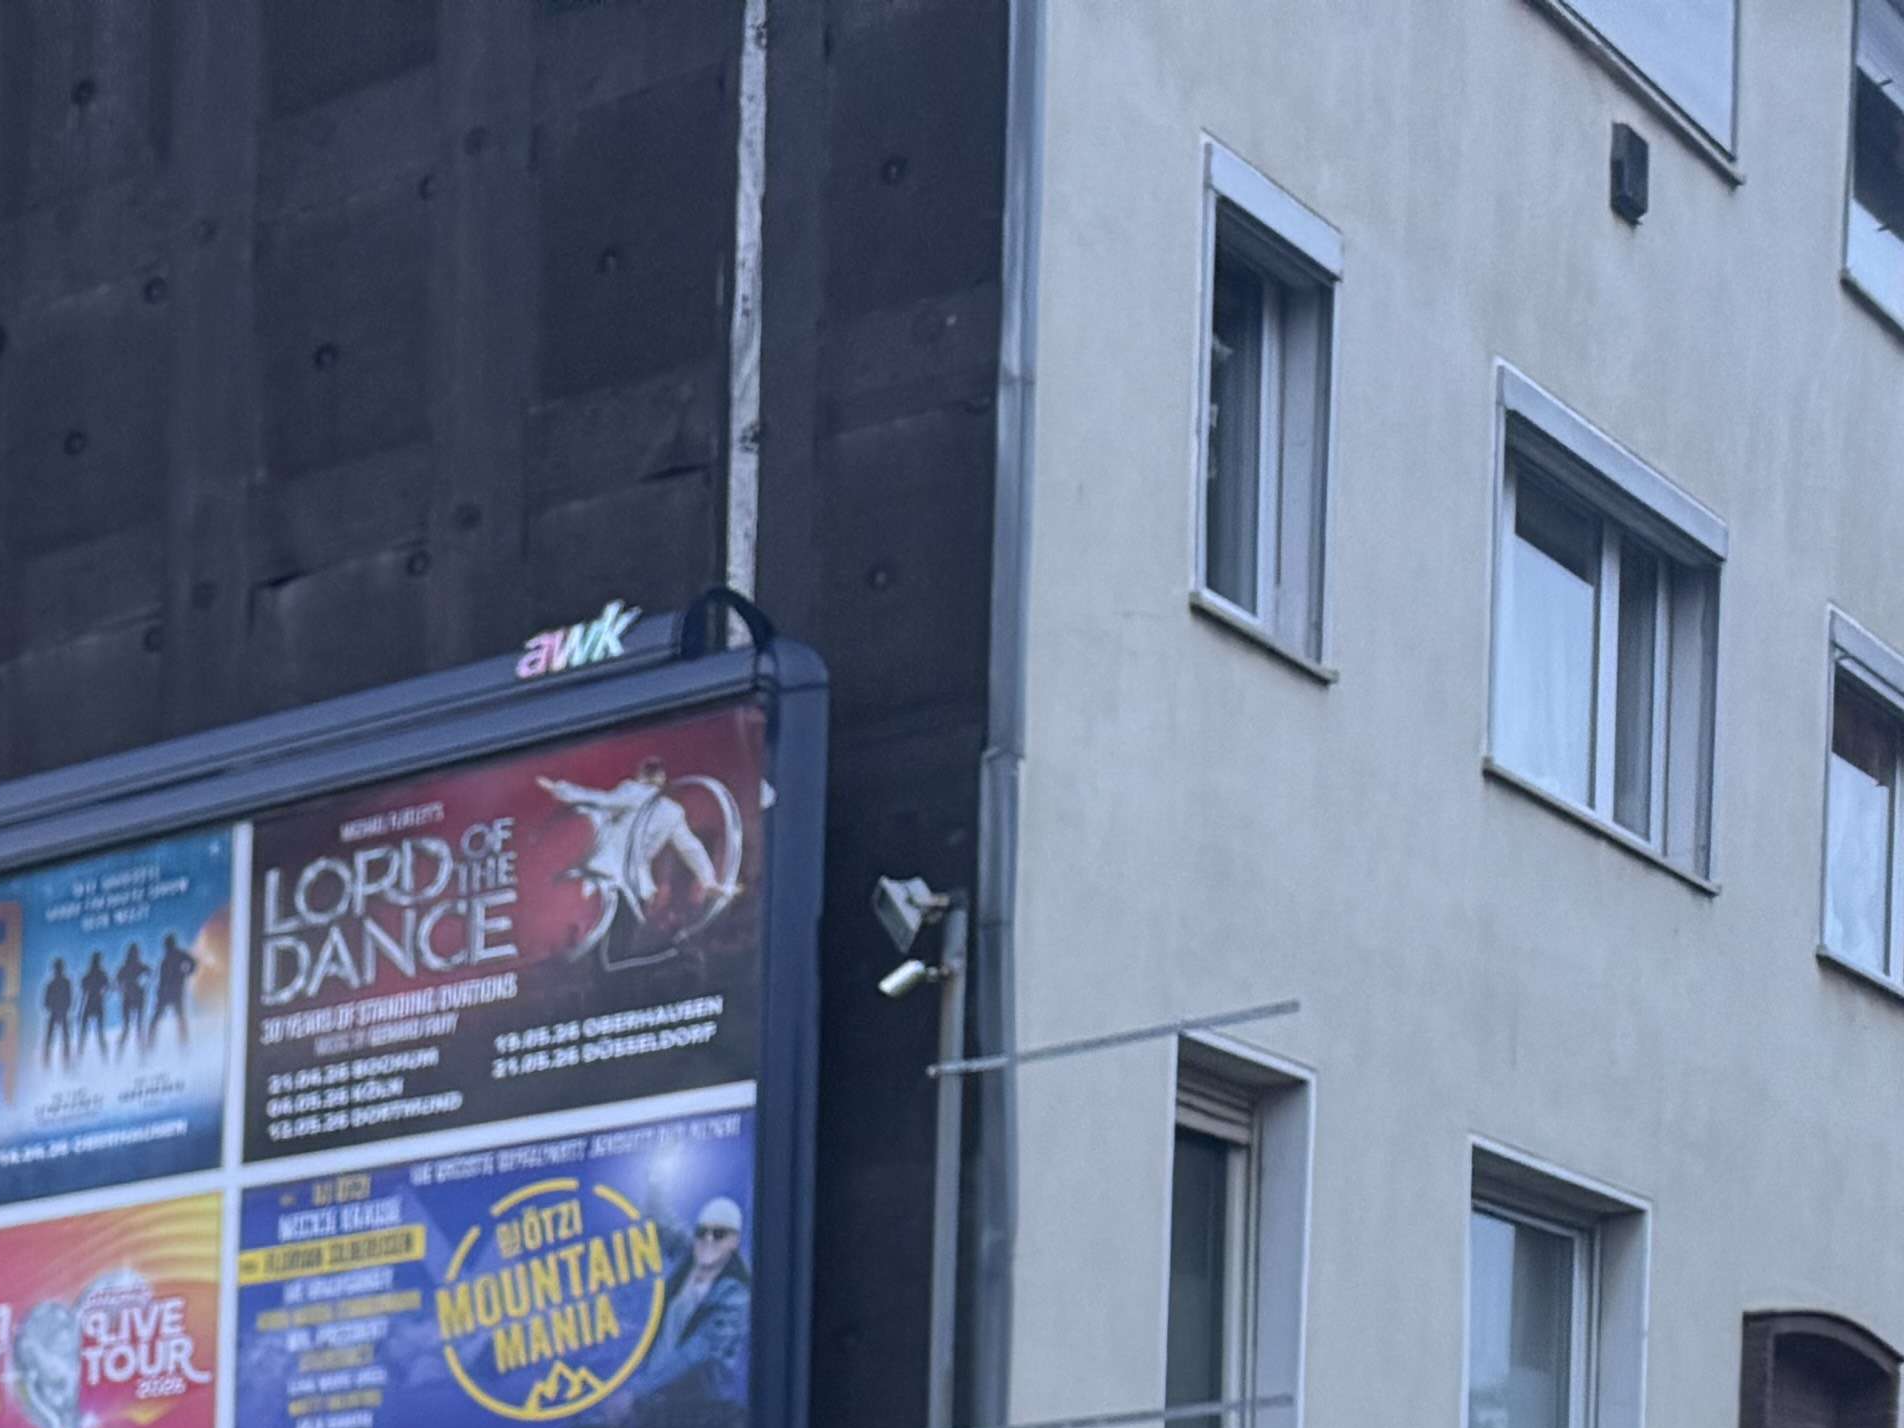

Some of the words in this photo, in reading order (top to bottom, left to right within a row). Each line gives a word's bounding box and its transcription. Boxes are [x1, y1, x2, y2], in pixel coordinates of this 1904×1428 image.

[515, 598, 642, 679] awk
[459, 816, 516, 858] OF
[263, 837, 455, 935] LORD
[454, 850, 518, 896] THE
[260, 888, 519, 1005] DANCE
[582, 994, 724, 1038] OBERHAUSEN
[581, 1020, 718, 1064] DÜSSELDORF
[523, 1199, 584, 1250] ÖTZI
[434, 1217, 664, 1341] MOUNTAIN
[85, 1296, 187, 1345] LIVE
[494, 1292, 622, 1374] MANIA
[80, 1335, 213, 1386] TOUR
